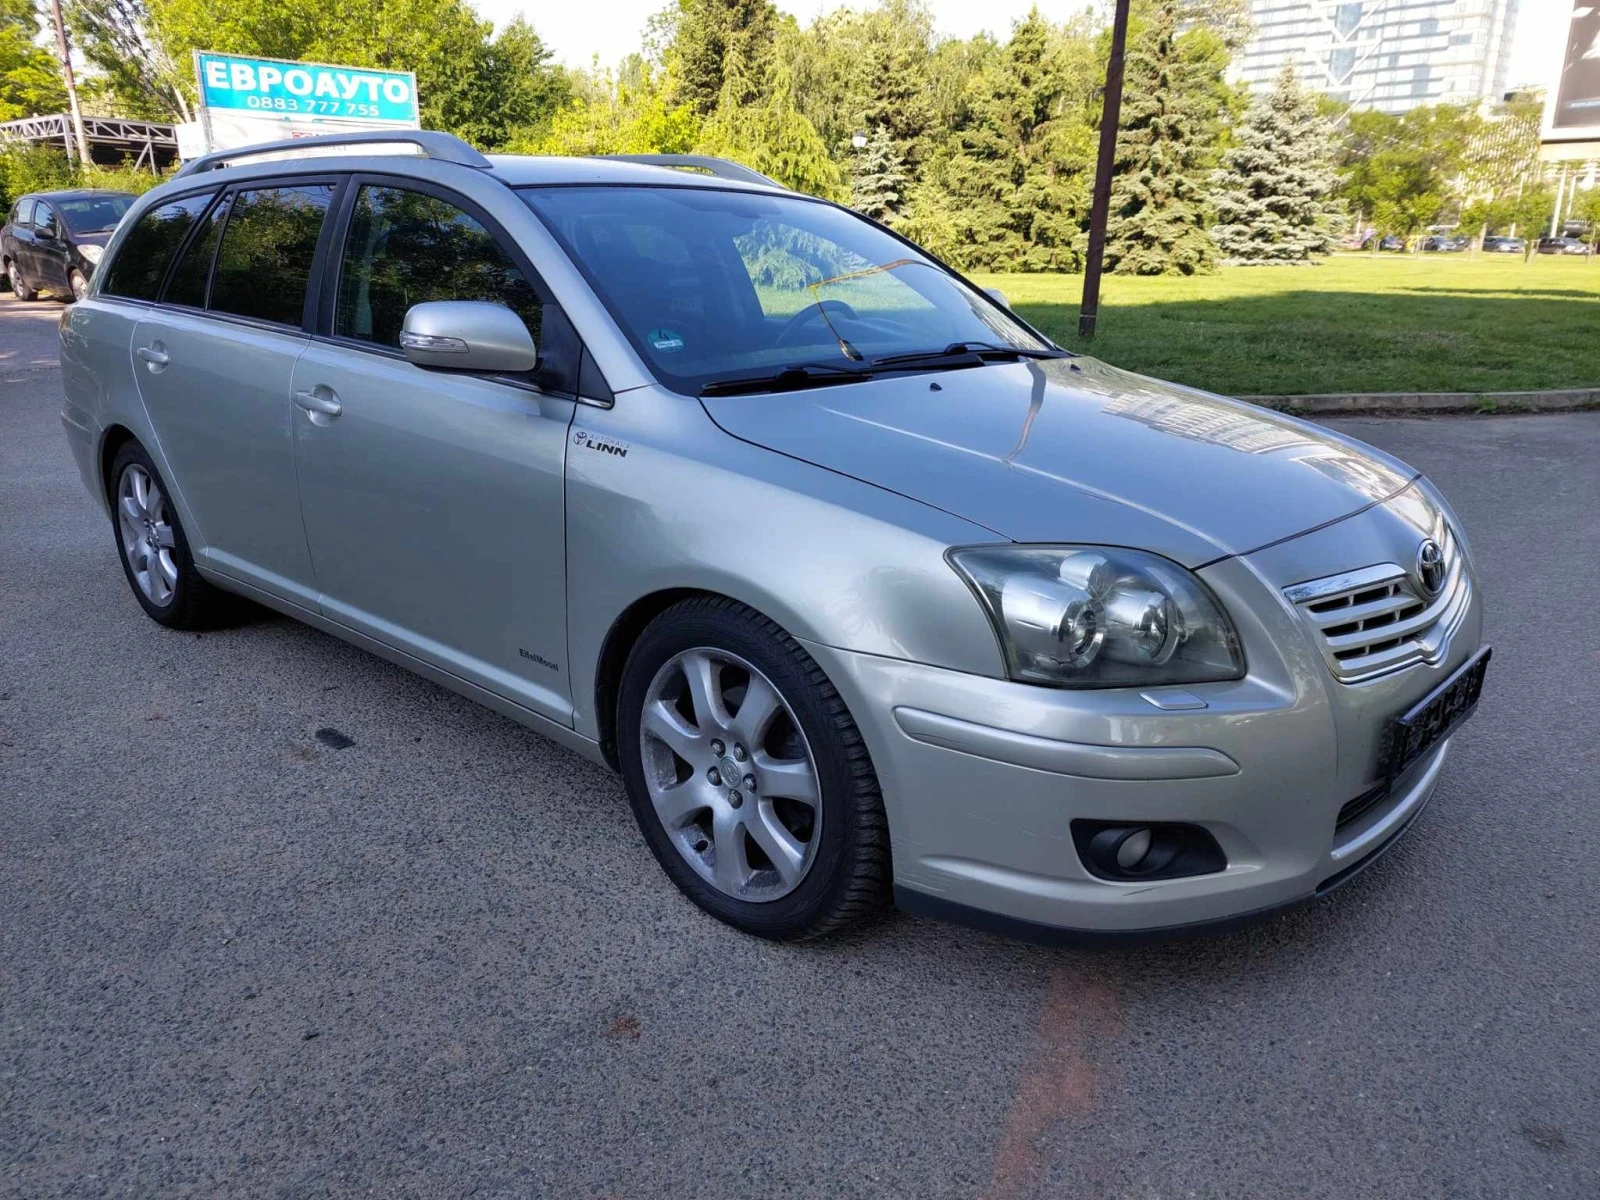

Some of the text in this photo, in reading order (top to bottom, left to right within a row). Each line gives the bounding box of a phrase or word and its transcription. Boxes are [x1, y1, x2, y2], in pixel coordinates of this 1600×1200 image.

[205, 60, 410, 104] ЕВРОАУТО
[246, 95, 380, 117] 0883 777 755
[586, 439, 628, 458] LINN
[589, 433, 631, 449] AUTOHAUS
